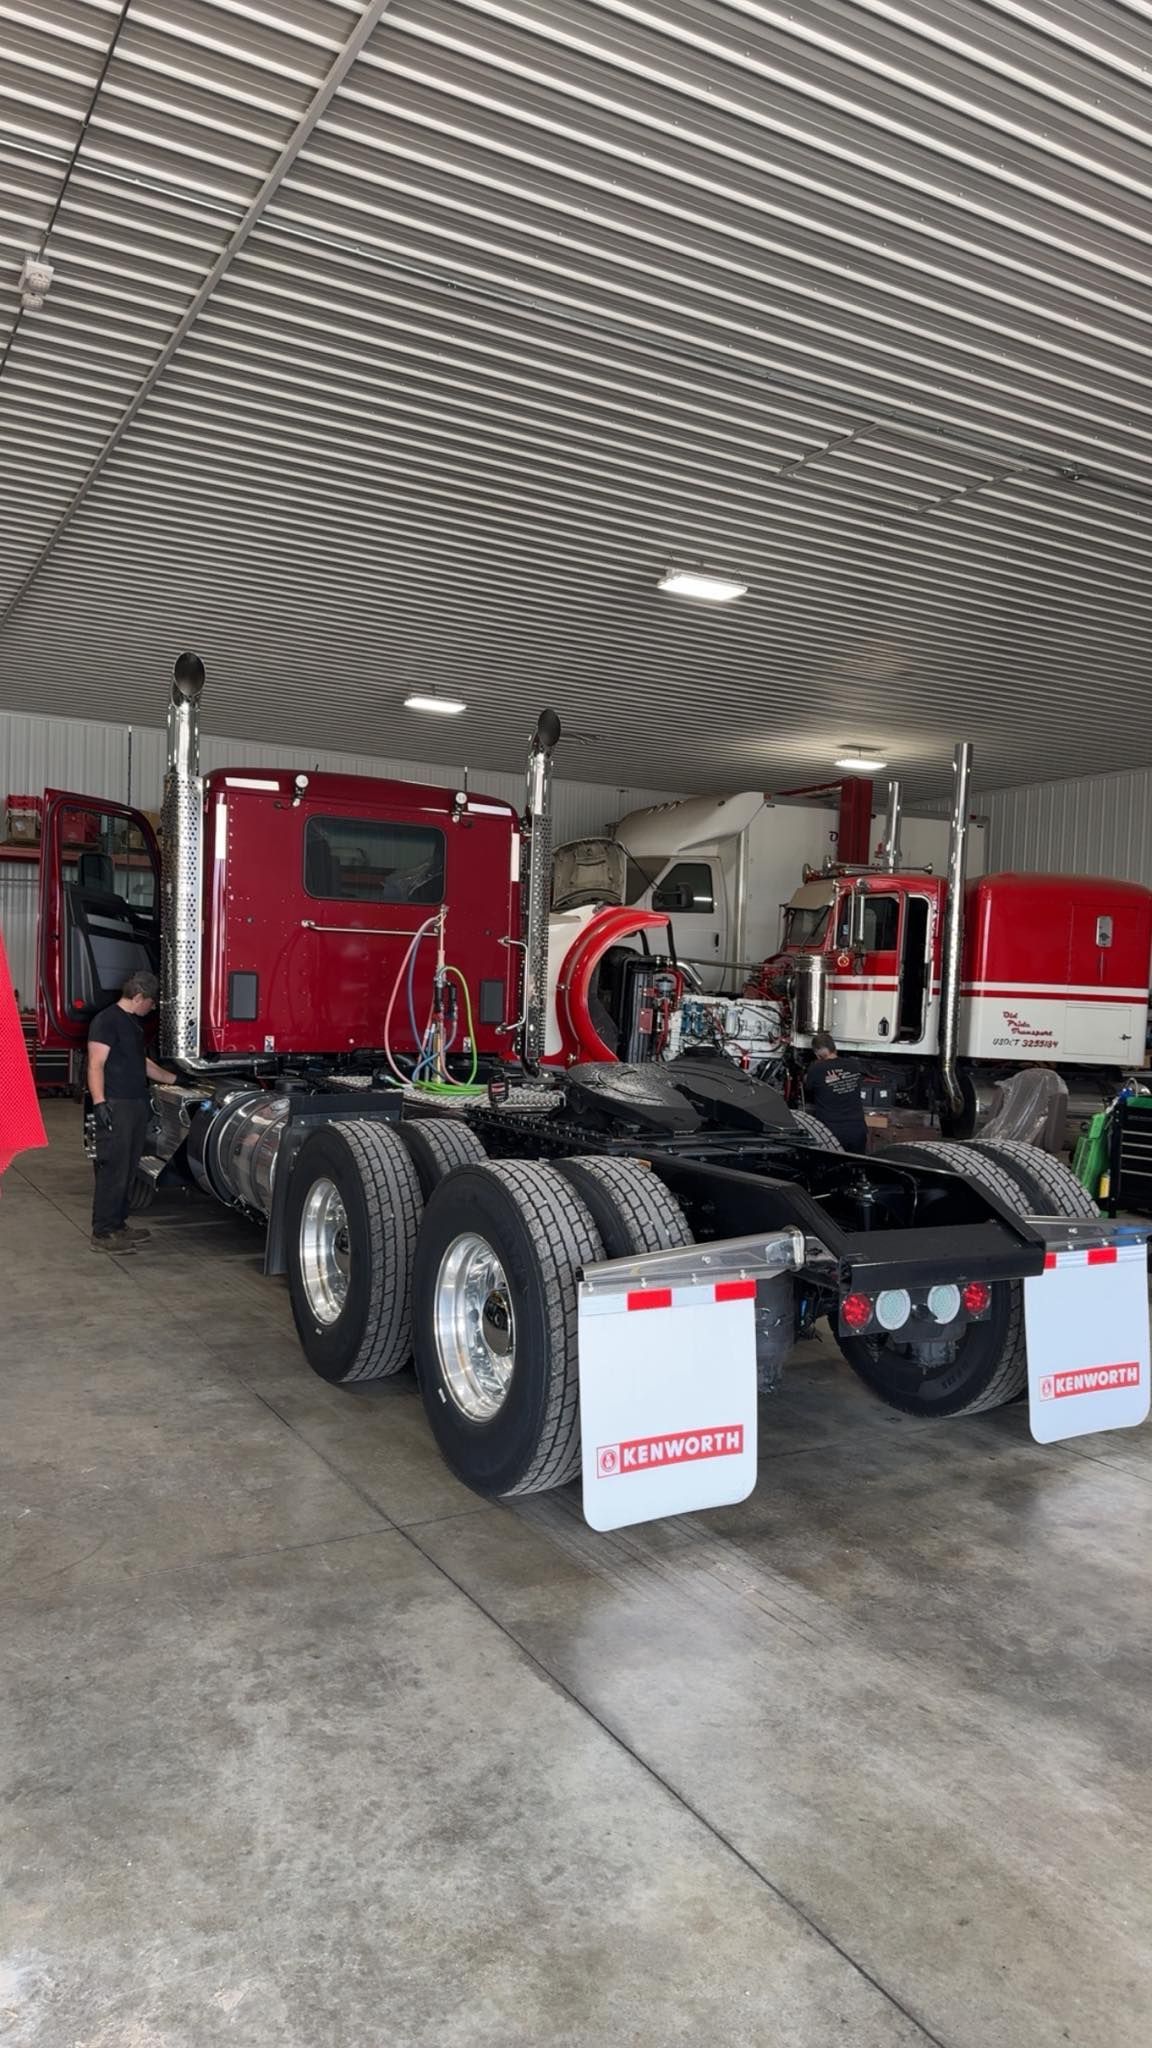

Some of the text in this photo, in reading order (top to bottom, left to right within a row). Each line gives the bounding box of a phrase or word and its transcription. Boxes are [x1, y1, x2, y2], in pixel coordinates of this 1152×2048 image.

[1003, 1011, 1018, 1019] Old
[1055, 1366, 1138, 1395] KENWORTH
[622, 1430, 740, 1468] KENWORTH
